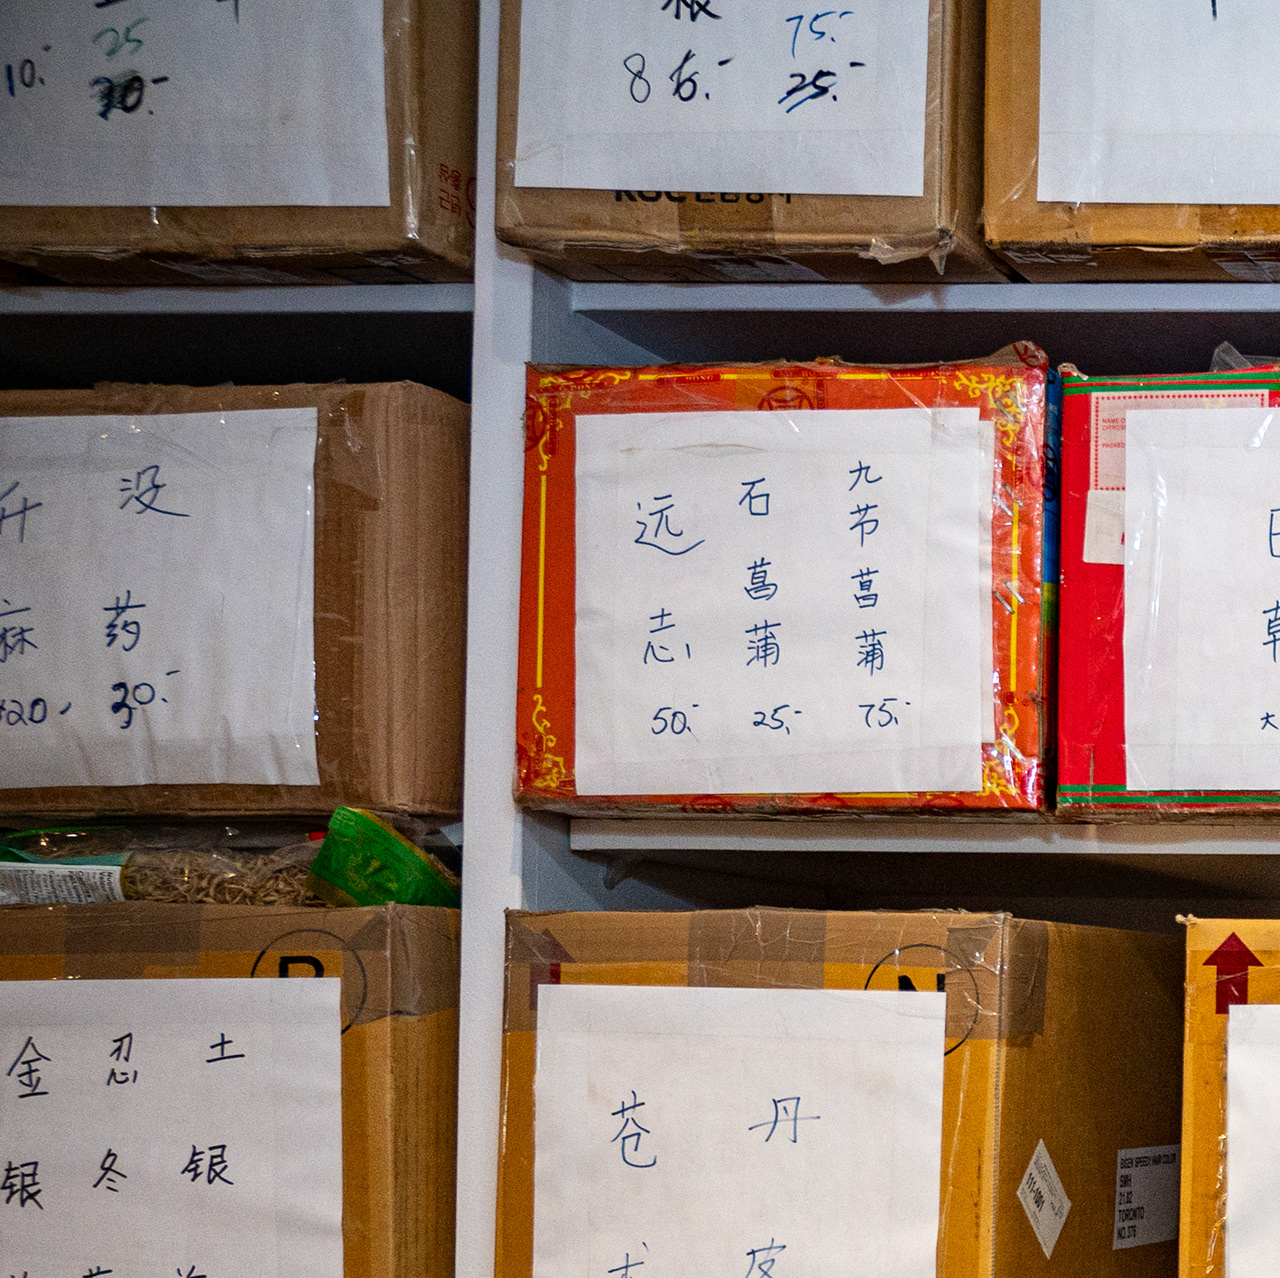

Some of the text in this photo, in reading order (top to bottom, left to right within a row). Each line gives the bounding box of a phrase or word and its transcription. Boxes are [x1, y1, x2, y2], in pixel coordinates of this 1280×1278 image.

[102, 463, 189, 653] 没药
[633, 492, 705, 665] 远志
[737, 476, 782, 668] 石菖蒲
[848, 460, 888, 676] 九节菖蒲
[1118, 1206, 1146, 1223] TORONTO
